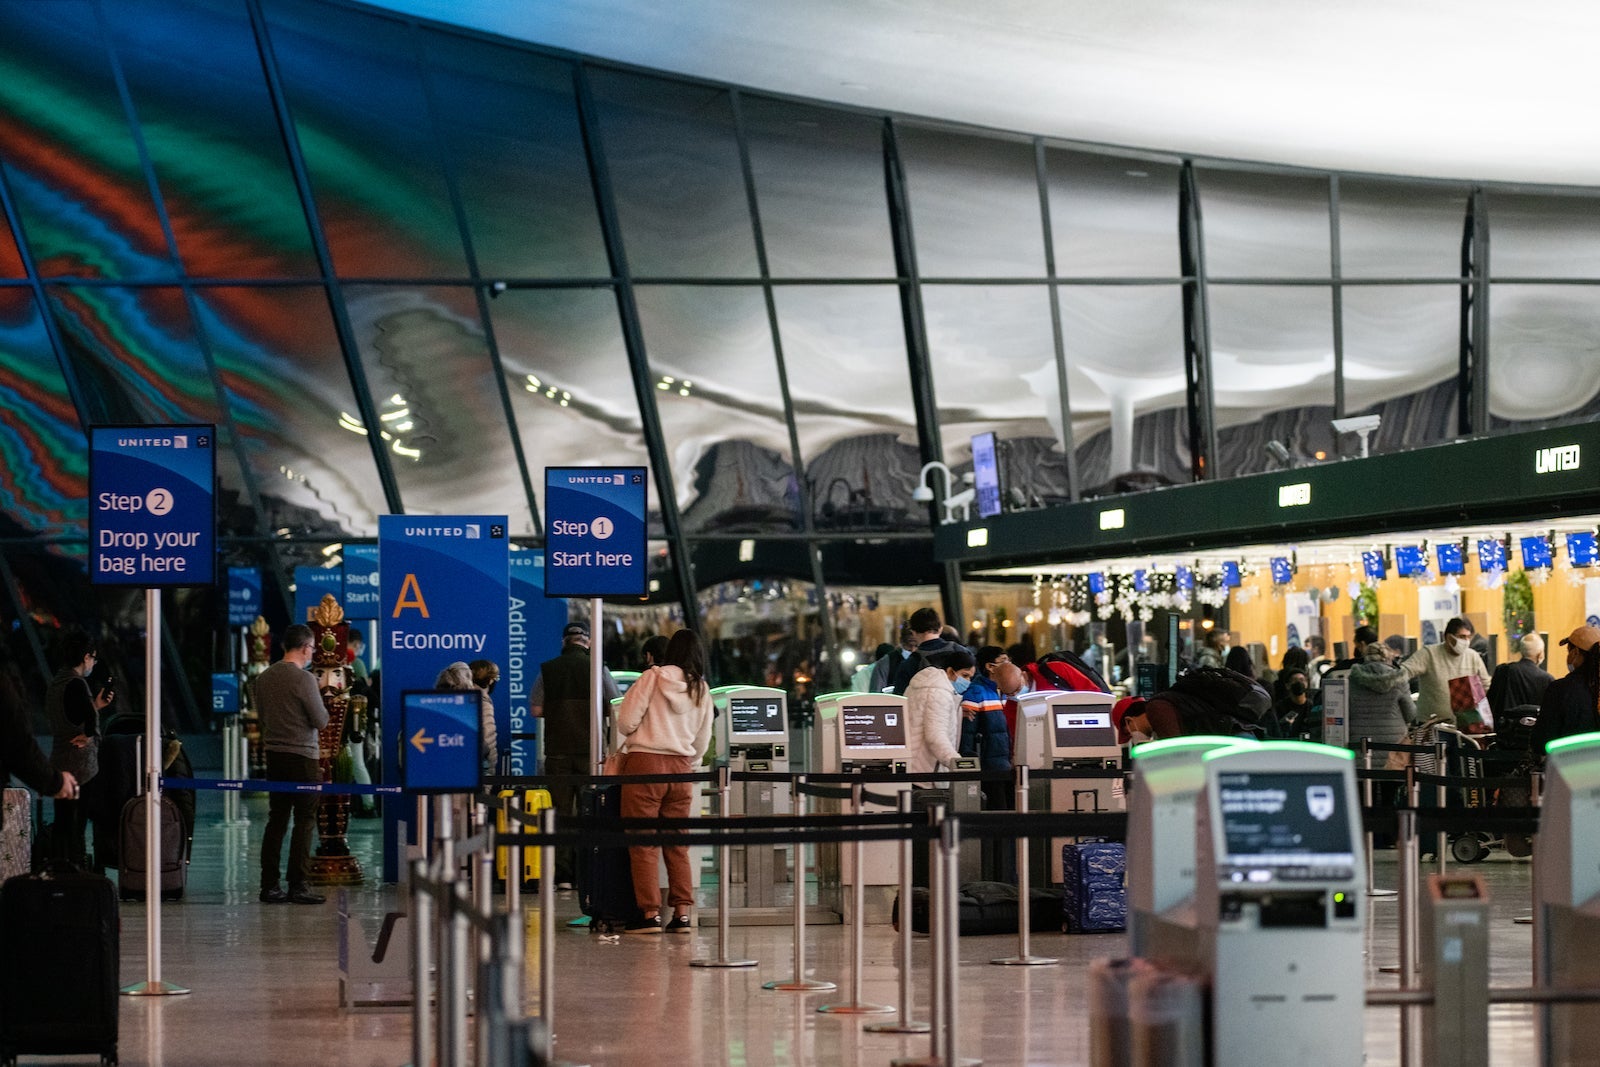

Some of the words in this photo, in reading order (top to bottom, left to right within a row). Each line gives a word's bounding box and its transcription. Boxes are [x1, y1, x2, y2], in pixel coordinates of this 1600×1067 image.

[118, 438, 171, 447] UNITED
[1535, 444, 1580, 473] UNITED
[568, 476, 612, 484] UNITED
[99, 492, 143, 513] Step
[405, 527, 463, 536] UNITED
[552, 520, 588, 537] Step
[99, 529, 148, 550] Drop
[154, 532, 200, 550] your
[99, 553, 136, 575] bag
[141, 553, 186, 572] here
[552, 551, 592, 567] Start
[596, 550, 633, 567] here
[392, 573, 430, 618] A
[391, 630, 487, 653] Economy
[509, 596, 528, 699] Additional
[438, 733, 464, 747] Exit
